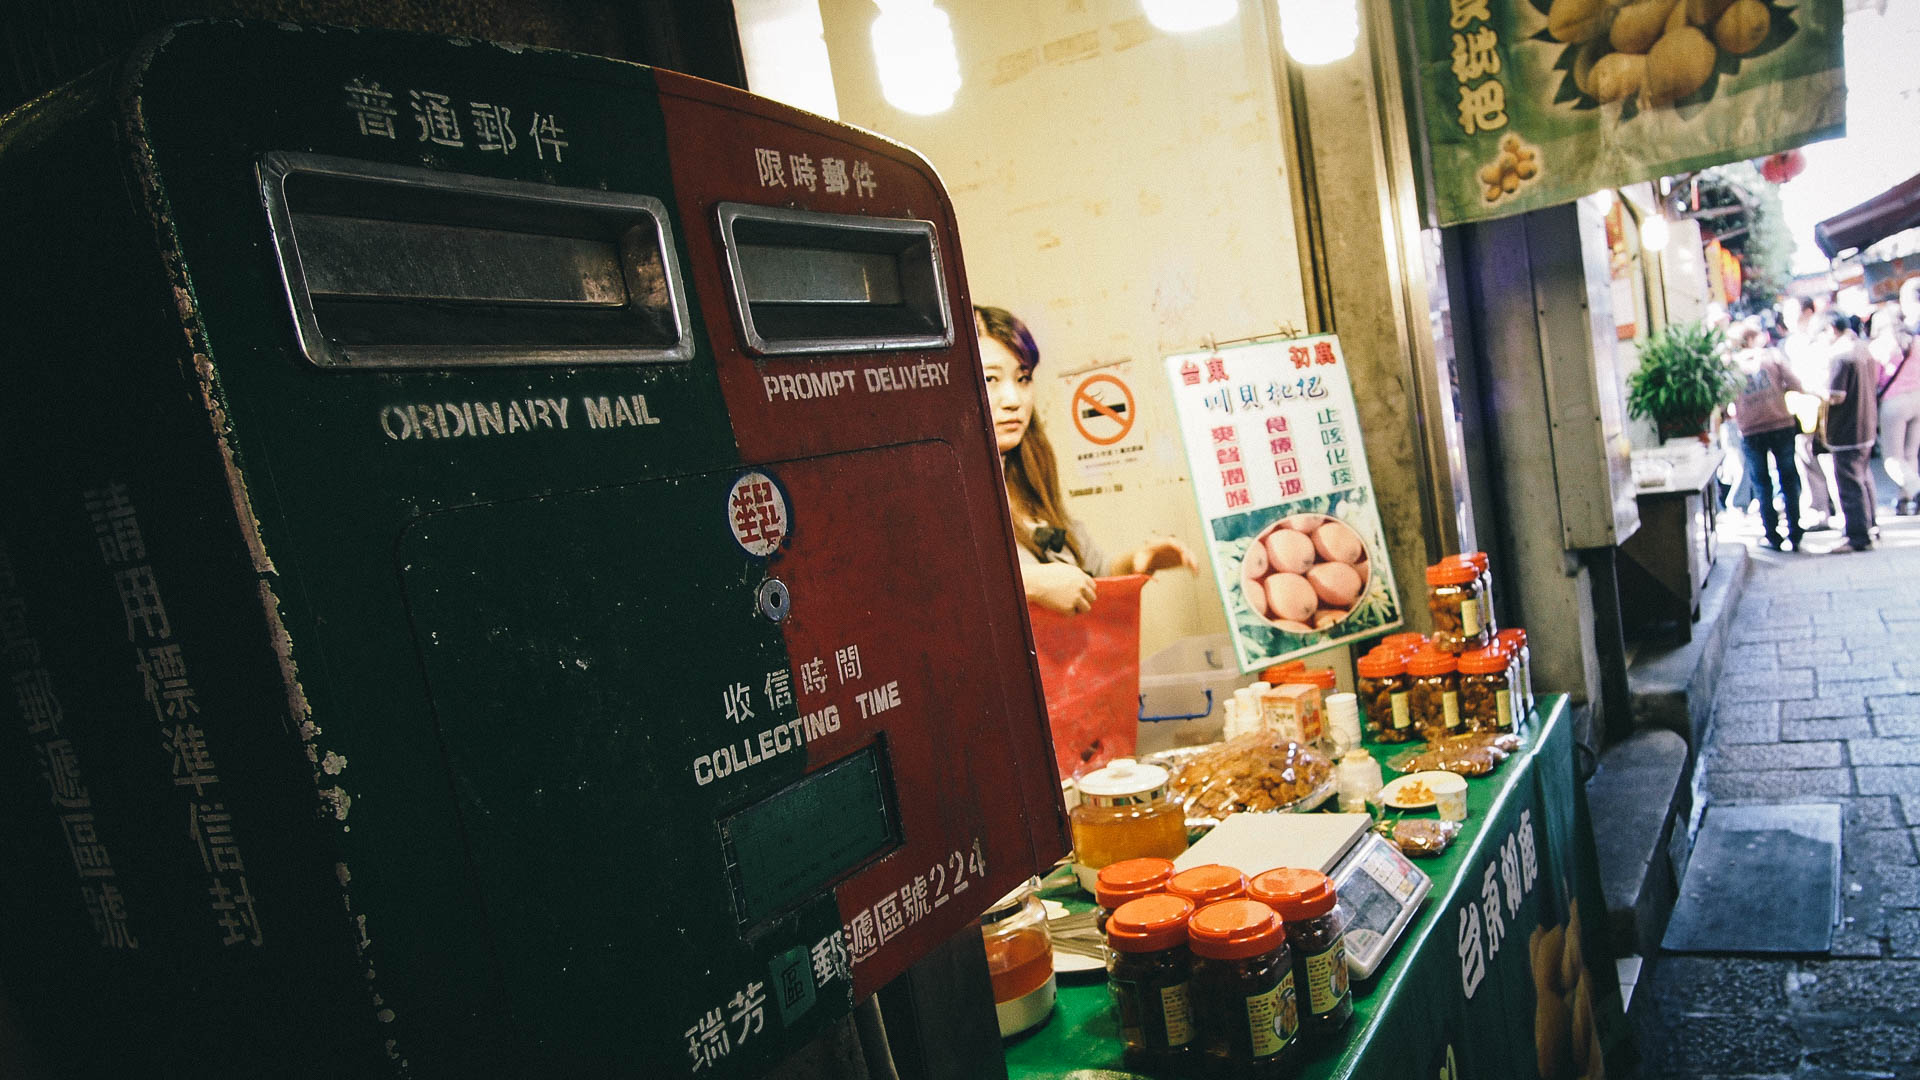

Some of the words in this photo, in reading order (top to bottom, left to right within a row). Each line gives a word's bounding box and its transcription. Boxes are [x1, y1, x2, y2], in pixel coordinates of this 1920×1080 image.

[344, 77, 569, 163] 普通郵件
[755, 148, 878, 198] 限時郵件
[763, 369, 855, 402] PROMPT
[864, 362, 950, 393] DELIVERY
[1180, 358, 1229, 386] 台東
[380, 398, 571, 441] ORDINARY
[587, 394, 660, 429] MAIL
[1317, 408, 1353, 486] 止咳化痰
[83, 483, 264, 948] 請用標準信封
[724, 645, 862, 725] 收信時間
[694, 705, 841, 786] COLLECTING
[857, 681, 901, 720] TIME
